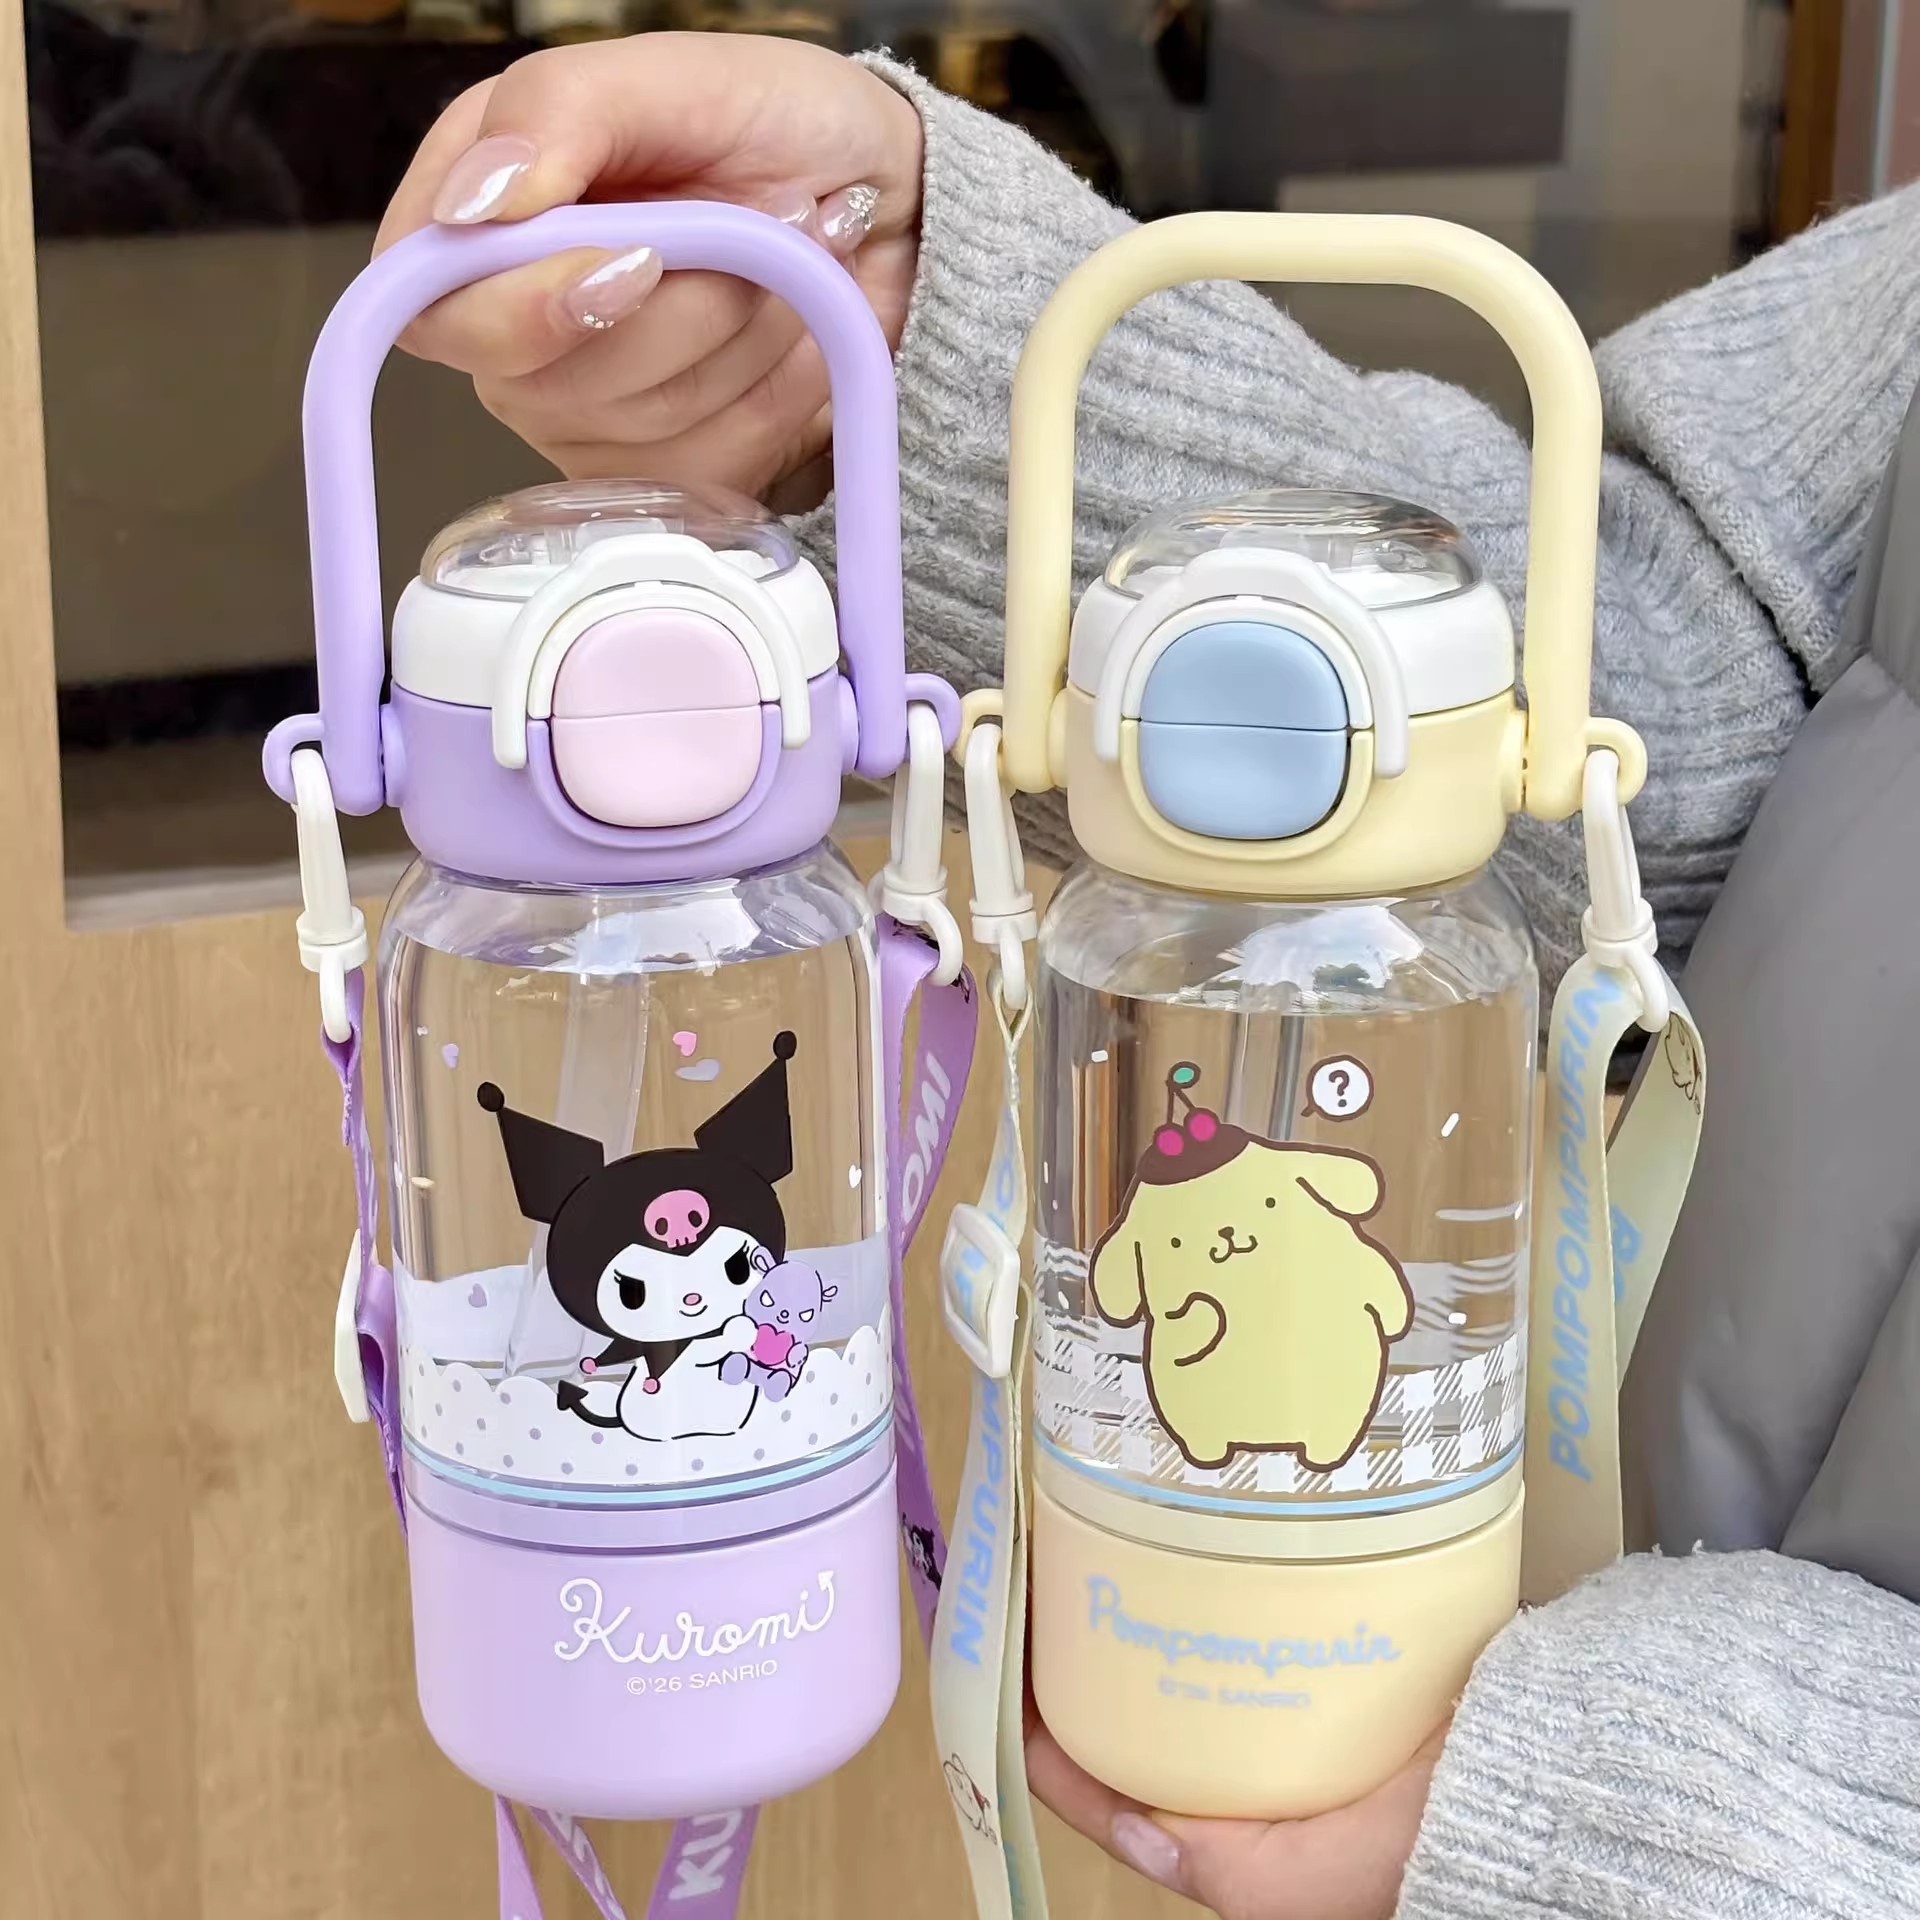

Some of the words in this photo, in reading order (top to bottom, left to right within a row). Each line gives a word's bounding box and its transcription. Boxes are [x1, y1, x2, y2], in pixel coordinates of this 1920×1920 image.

[1328, 1069, 1350, 1108] ?
[902, 1051, 951, 1240] OMI
[1546, 968, 1624, 1483] POMPOMPURIN
[554, 1570, 835, 1663] Kuromi
[1087, 1574, 1402, 1679] Pompompurin
[689, 1659, 778, 1689] SANRIO
